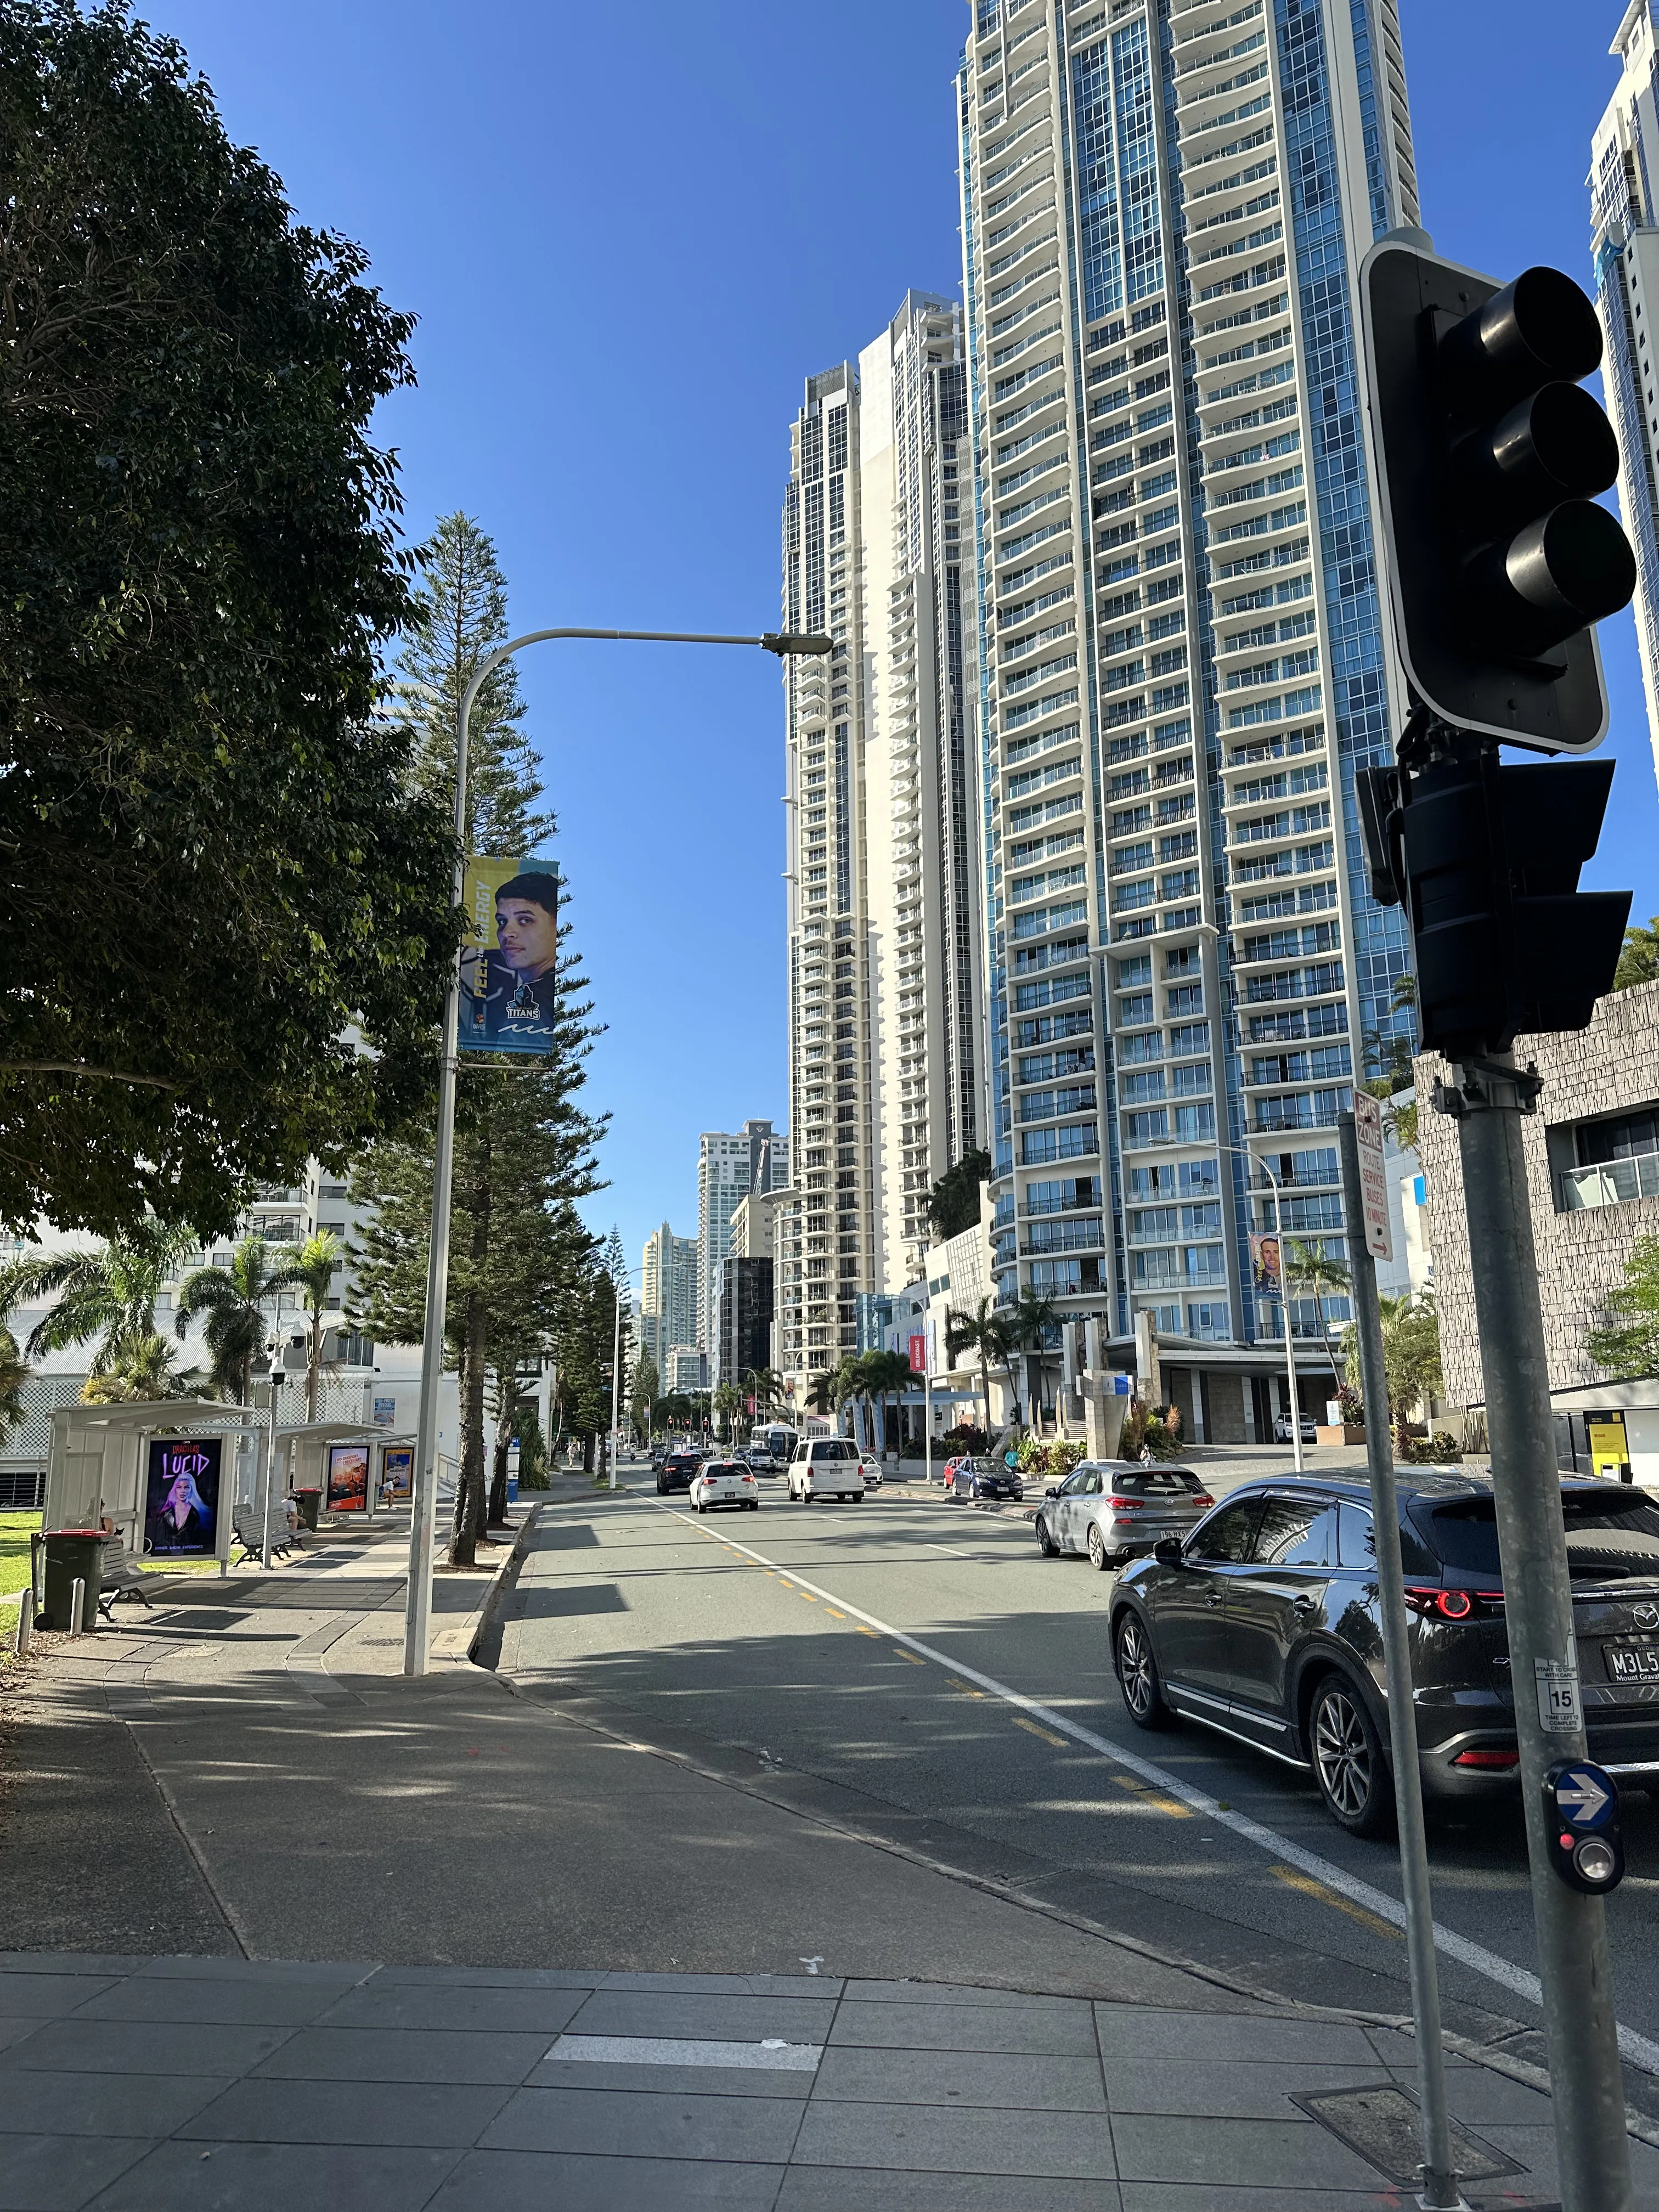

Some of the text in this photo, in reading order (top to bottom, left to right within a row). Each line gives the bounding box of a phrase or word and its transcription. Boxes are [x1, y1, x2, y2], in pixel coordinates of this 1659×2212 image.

[474, 880, 491, 944] ENERGY
[473, 958, 488, 998] FEEL
[508, 1008, 538, 1019] TITANS
[1358, 1096, 1377, 1122] BUS
[1357, 1122, 1381, 1150] ZONE
[1363, 1150, 1380, 1170] ROUTE
[1362, 1168, 1384, 1189] SERVICE
[1367, 1187, 1383, 1206] BUSES
[1365, 1206, 1387, 1227] 10 MINUTE
[162, 1453, 210, 1479] LUCID
[1612, 1651, 1659, 1674] M3L5
[1551, 1690, 1572, 1707] 15
